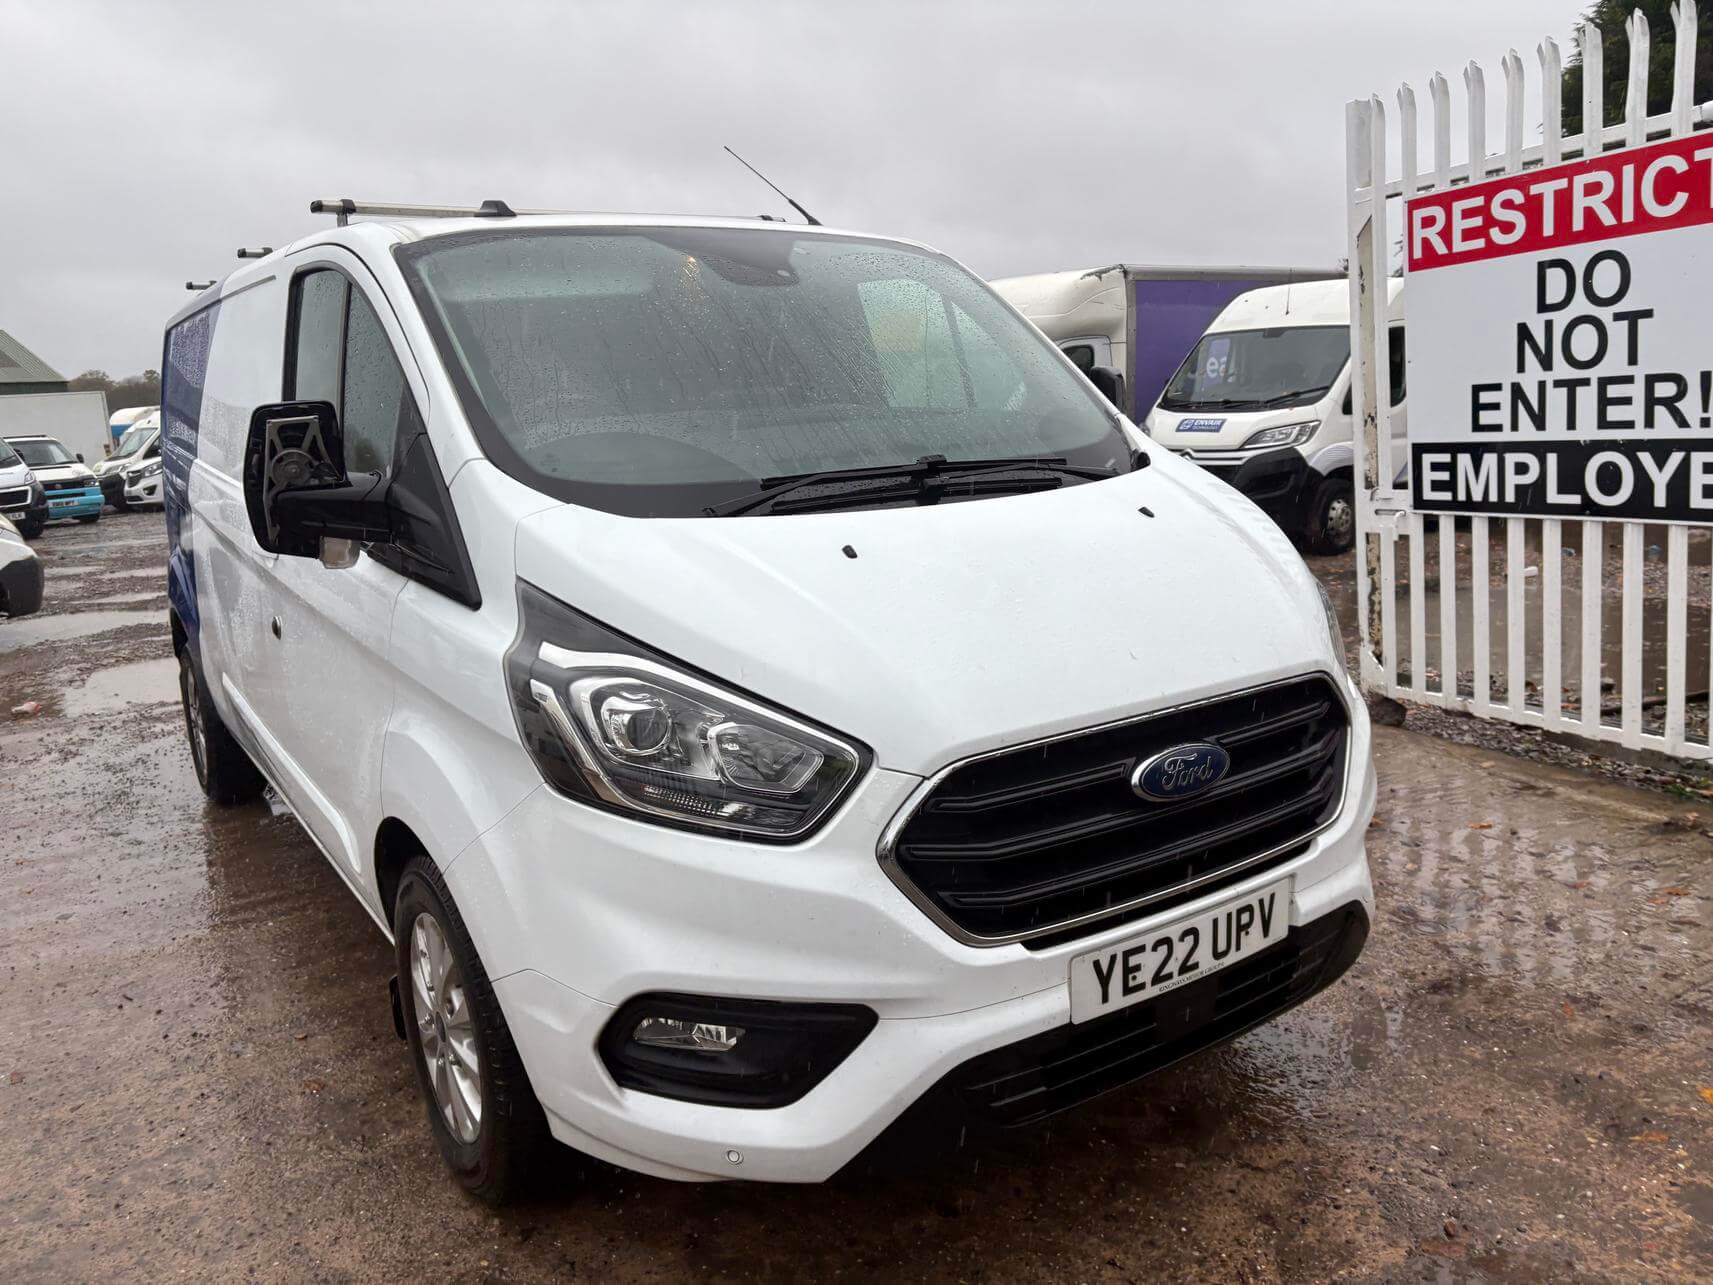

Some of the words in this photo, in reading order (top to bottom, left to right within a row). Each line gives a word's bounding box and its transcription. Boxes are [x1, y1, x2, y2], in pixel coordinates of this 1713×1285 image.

[1536, 250, 1632, 314] DO
[1516, 309, 1654, 374] NOT
[1471, 370, 1713, 433] ENTER!
[1422, 450, 1713, 510] EMPLOYE
[1161, 752, 1214, 791] Ford
[1092, 926, 1200, 1005] YE22
[1212, 892, 1276, 960] UPV
